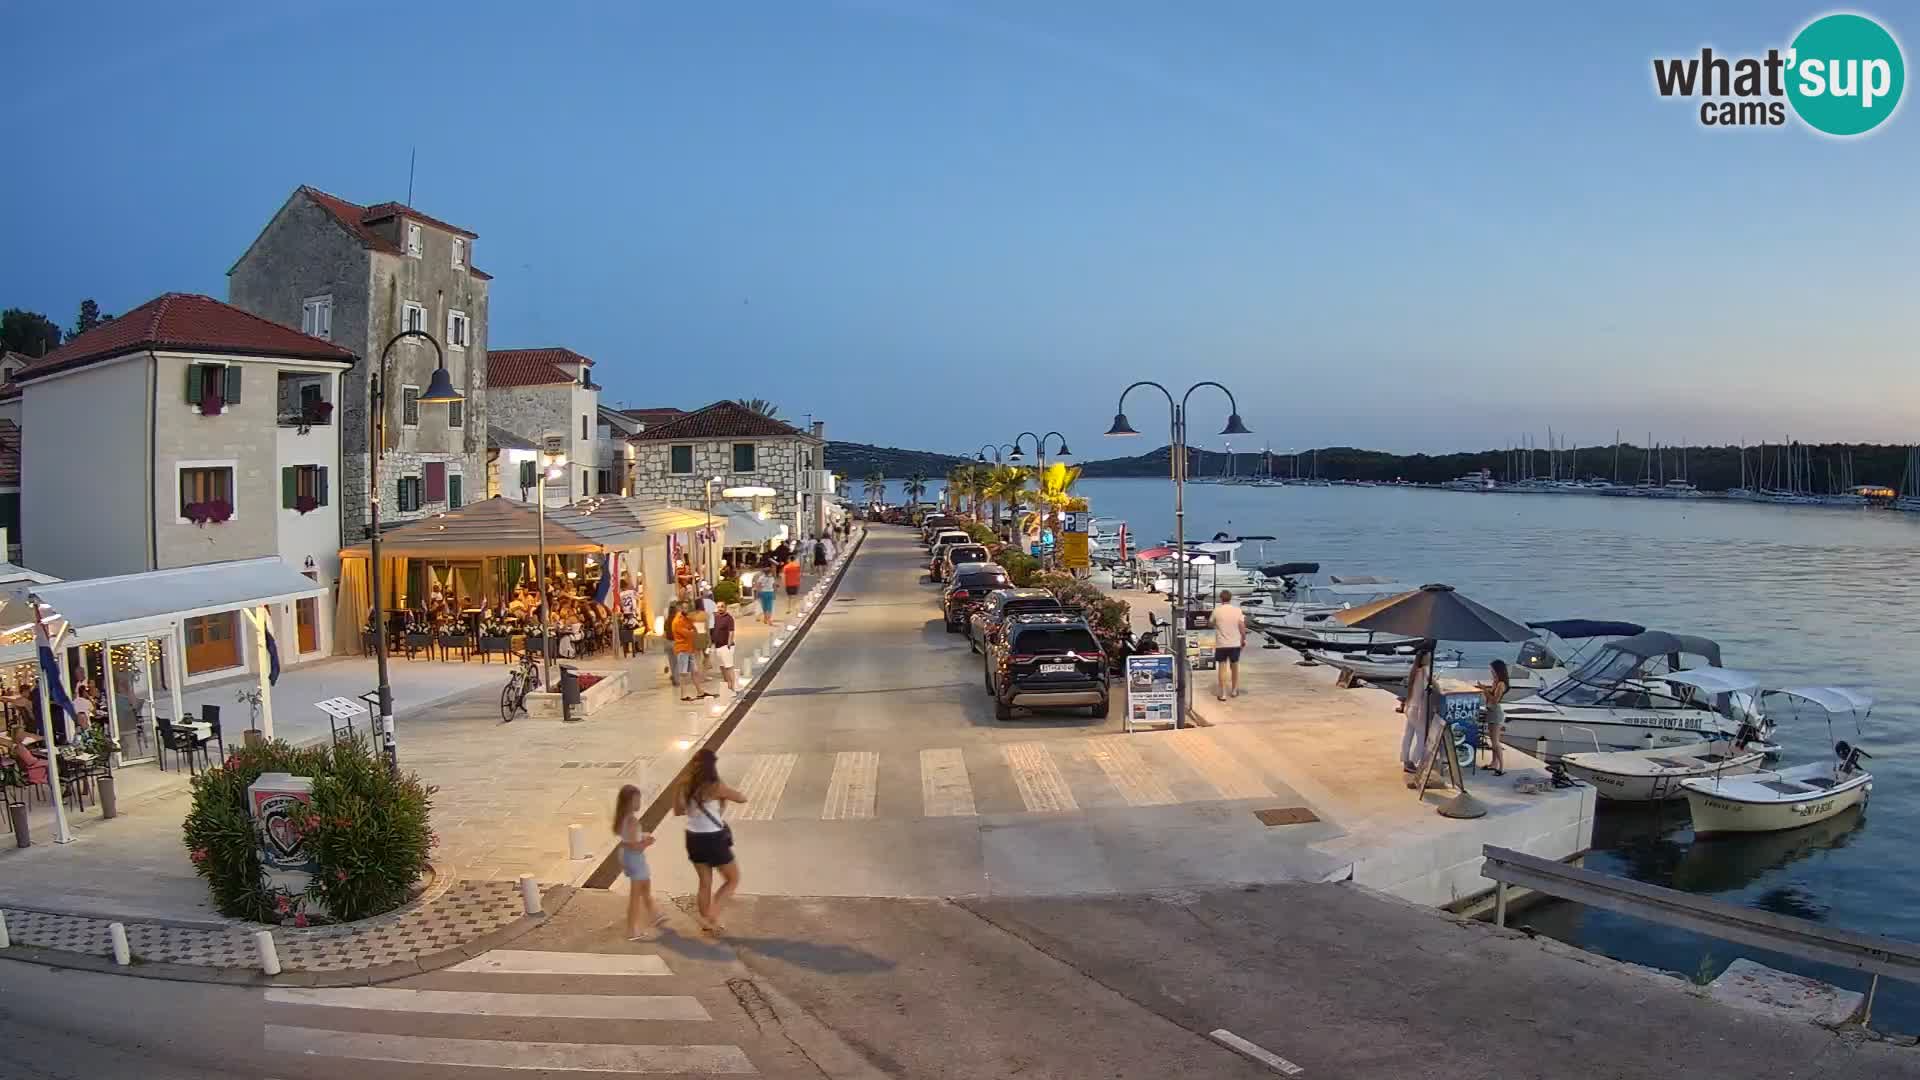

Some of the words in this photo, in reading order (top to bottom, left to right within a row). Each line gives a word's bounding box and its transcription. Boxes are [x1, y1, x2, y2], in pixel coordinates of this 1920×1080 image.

[1064, 514, 1075, 530] P
[1447, 698, 1479, 711] RENT
[1446, 711, 1453, 720] A
[1685, 718, 1703, 729] BOAT
